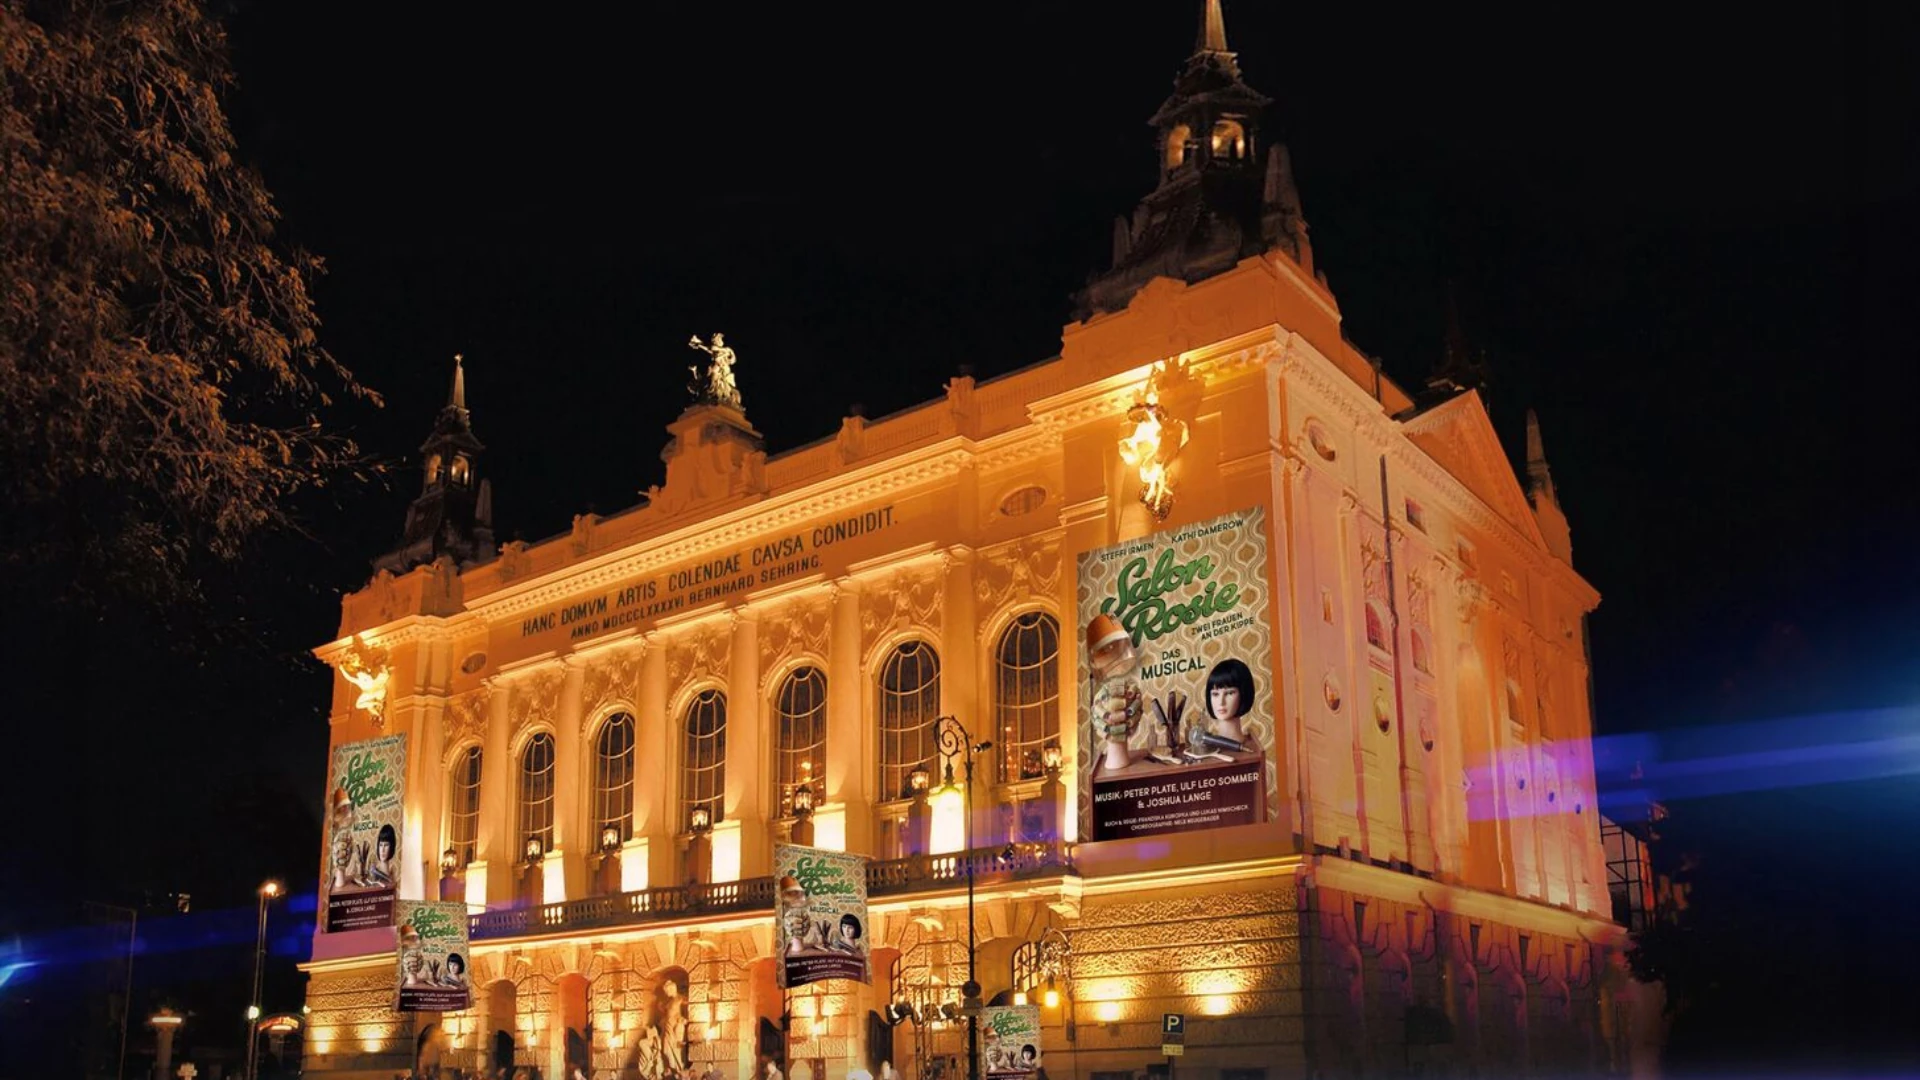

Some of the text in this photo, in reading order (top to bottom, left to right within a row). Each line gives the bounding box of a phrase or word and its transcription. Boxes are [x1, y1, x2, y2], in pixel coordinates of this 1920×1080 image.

[1101, 519, 1244, 562] STEFFI IRMEN KATHI DAMEROW
[523, 506, 898, 636] HANC DOMVM ARTIS COLENDAE CAVSA CONDIDIT.
[1102, 548, 1216, 617] Salon
[571, 621, 599, 639] ANNO
[689, 573, 755, 605] BERNHARD
[1122, 581, 1241, 648] Rosie
[1191, 612, 1243, 635] ZWEI FRAUEN
[1201, 617, 1255, 641] AN DER KIPPE
[1162, 649, 1181, 660] DAS
[1141, 656, 1206, 681] MUSICAL
[340, 751, 387, 789] Salon
[1123, 787, 1150, 800] PETER
[1151, 783, 1179, 797] PLATE,
[1180, 780, 1197, 791] ULF
[1198, 777, 1216, 789] LEO
[1218, 772, 1259, 786] SOMMER
[1137, 791, 1212, 809] & JOSHUA LANGE
[788, 857, 844, 879] Salon
[800, 877, 856, 897] Rosie
[406, 907, 451, 926] Salon
[1167, 1016, 1180, 1031] P
